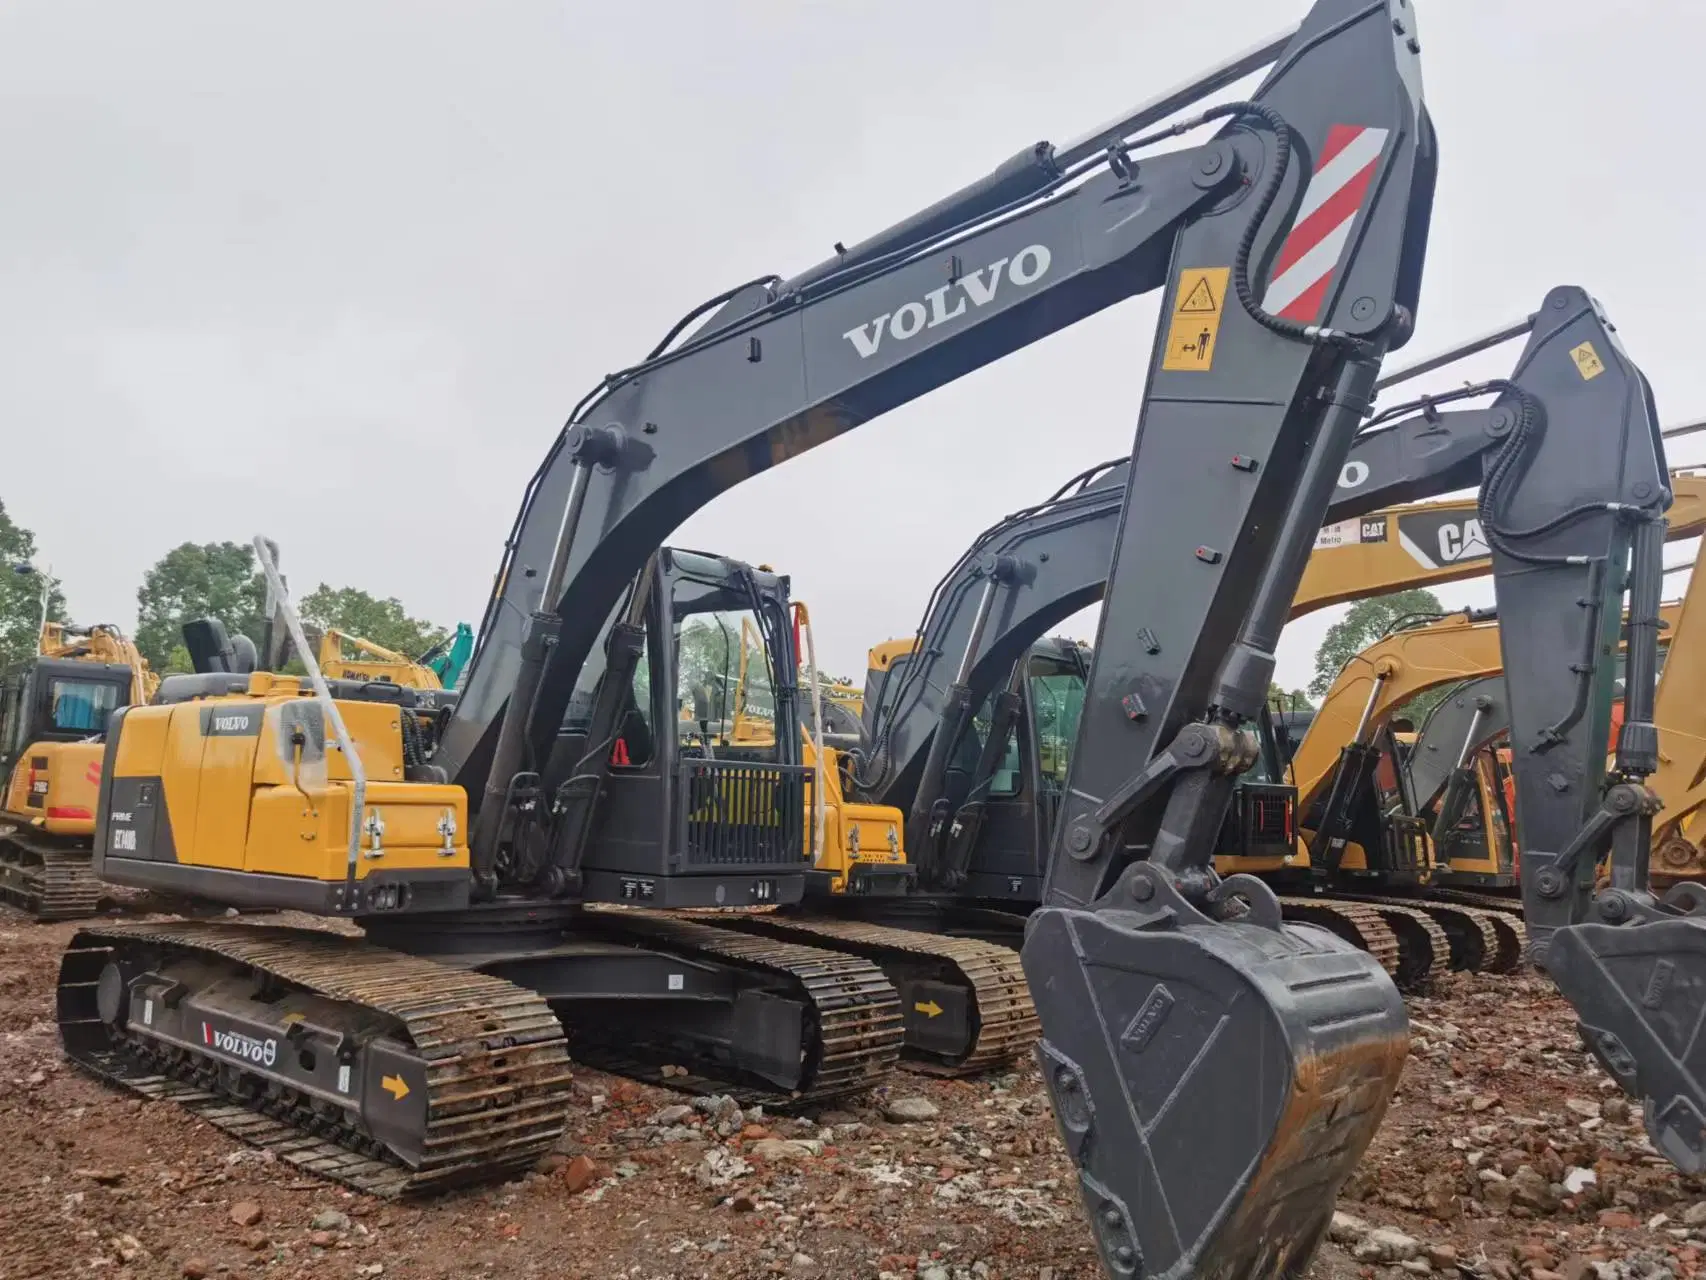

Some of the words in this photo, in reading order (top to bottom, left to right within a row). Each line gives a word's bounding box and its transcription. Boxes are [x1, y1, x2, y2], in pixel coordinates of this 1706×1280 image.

[843, 244, 1051, 359] VOLVO
[1362, 522, 1386, 538] CAT
[1438, 518, 1492, 561] CA
[215, 716, 249, 731] VOLVO
[214, 1030, 263, 1062] VOLVO
